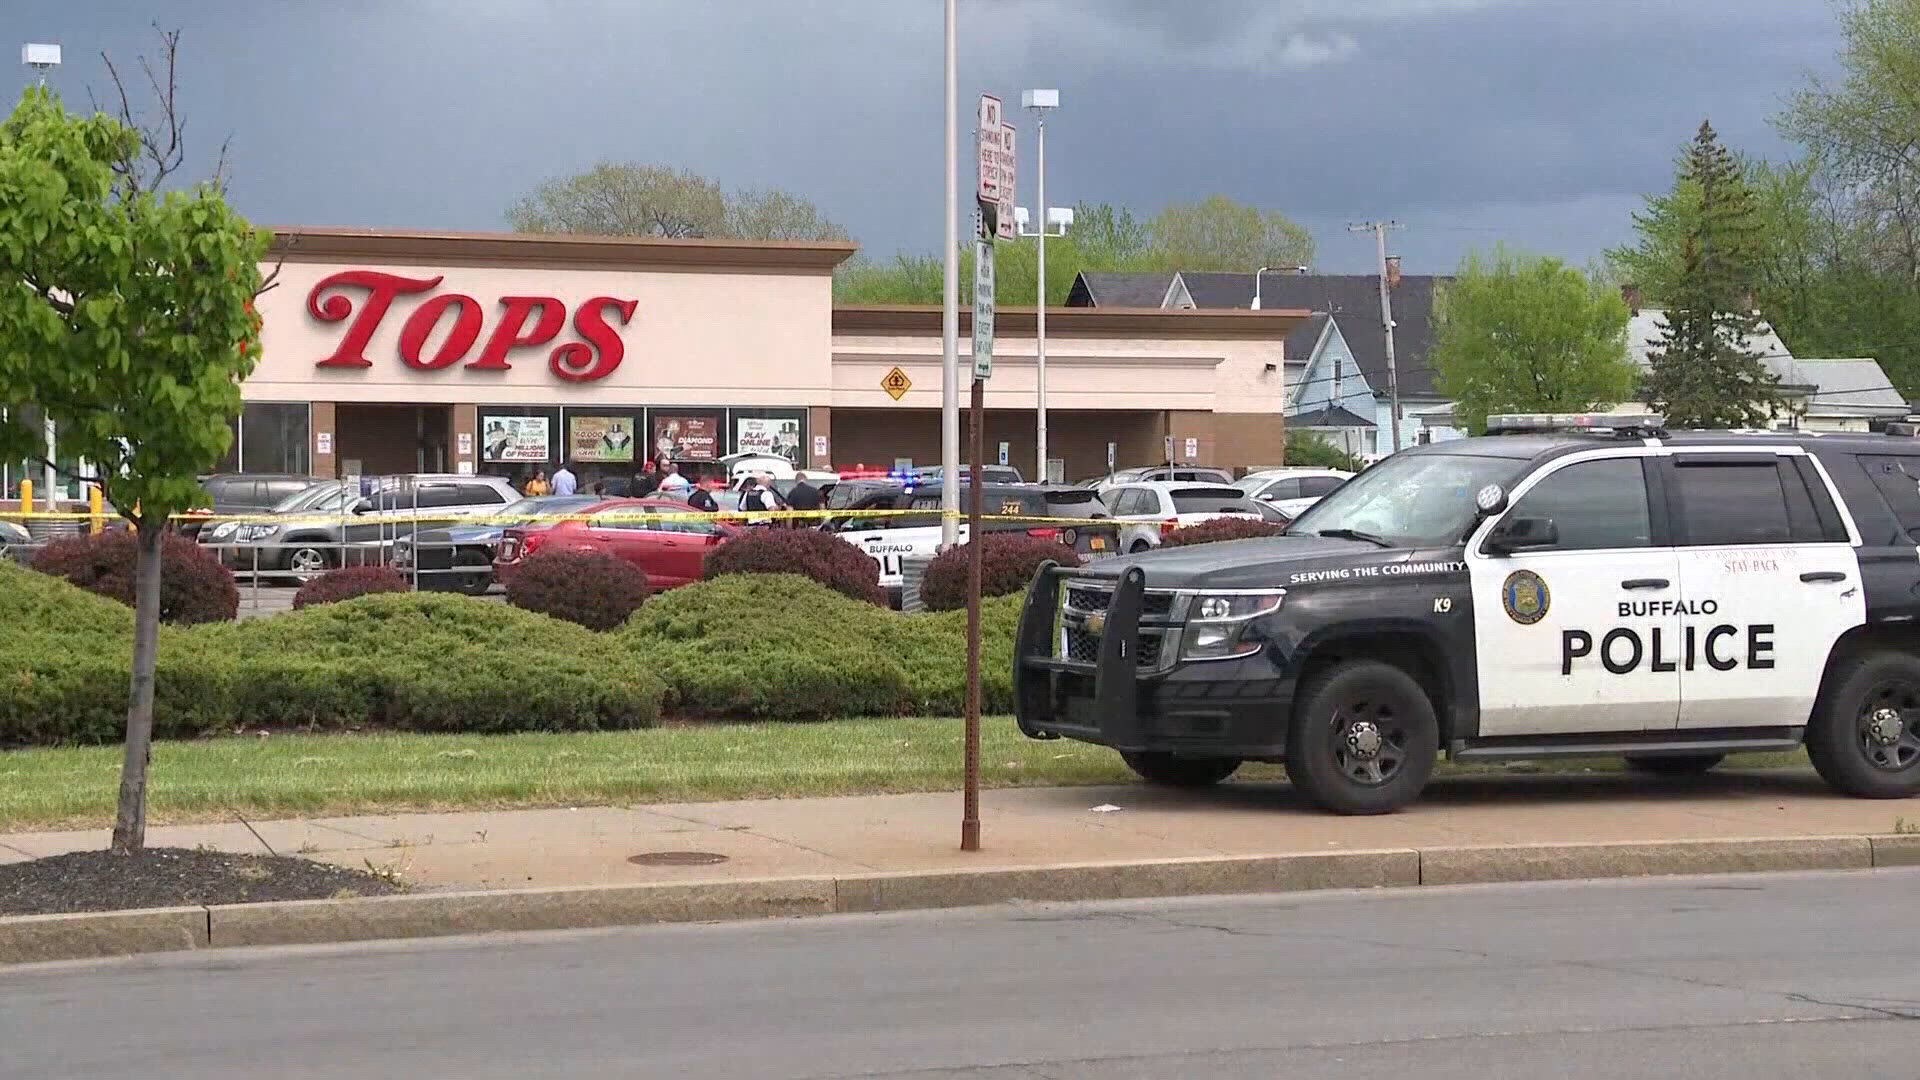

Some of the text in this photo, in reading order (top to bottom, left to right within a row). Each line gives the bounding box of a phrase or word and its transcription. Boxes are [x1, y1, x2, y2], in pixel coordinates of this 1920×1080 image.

[987, 104, 996, 125] NO
[1004, 132, 1012, 151] NO
[307, 270, 639, 382] TOPS
[740, 439, 771, 447] ONLINE
[1001, 505, 1020, 515] 244
[869, 544, 913, 554] BUFFALO
[1290, 561, 1464, 584] SERVING THE COMMUNITY
[1725, 560, 1779, 573] STAY BACK
[1433, 598, 1452, 613] K9
[1618, 599, 1718, 617] BUFFALO
[1562, 624, 1775, 676] POLICE
